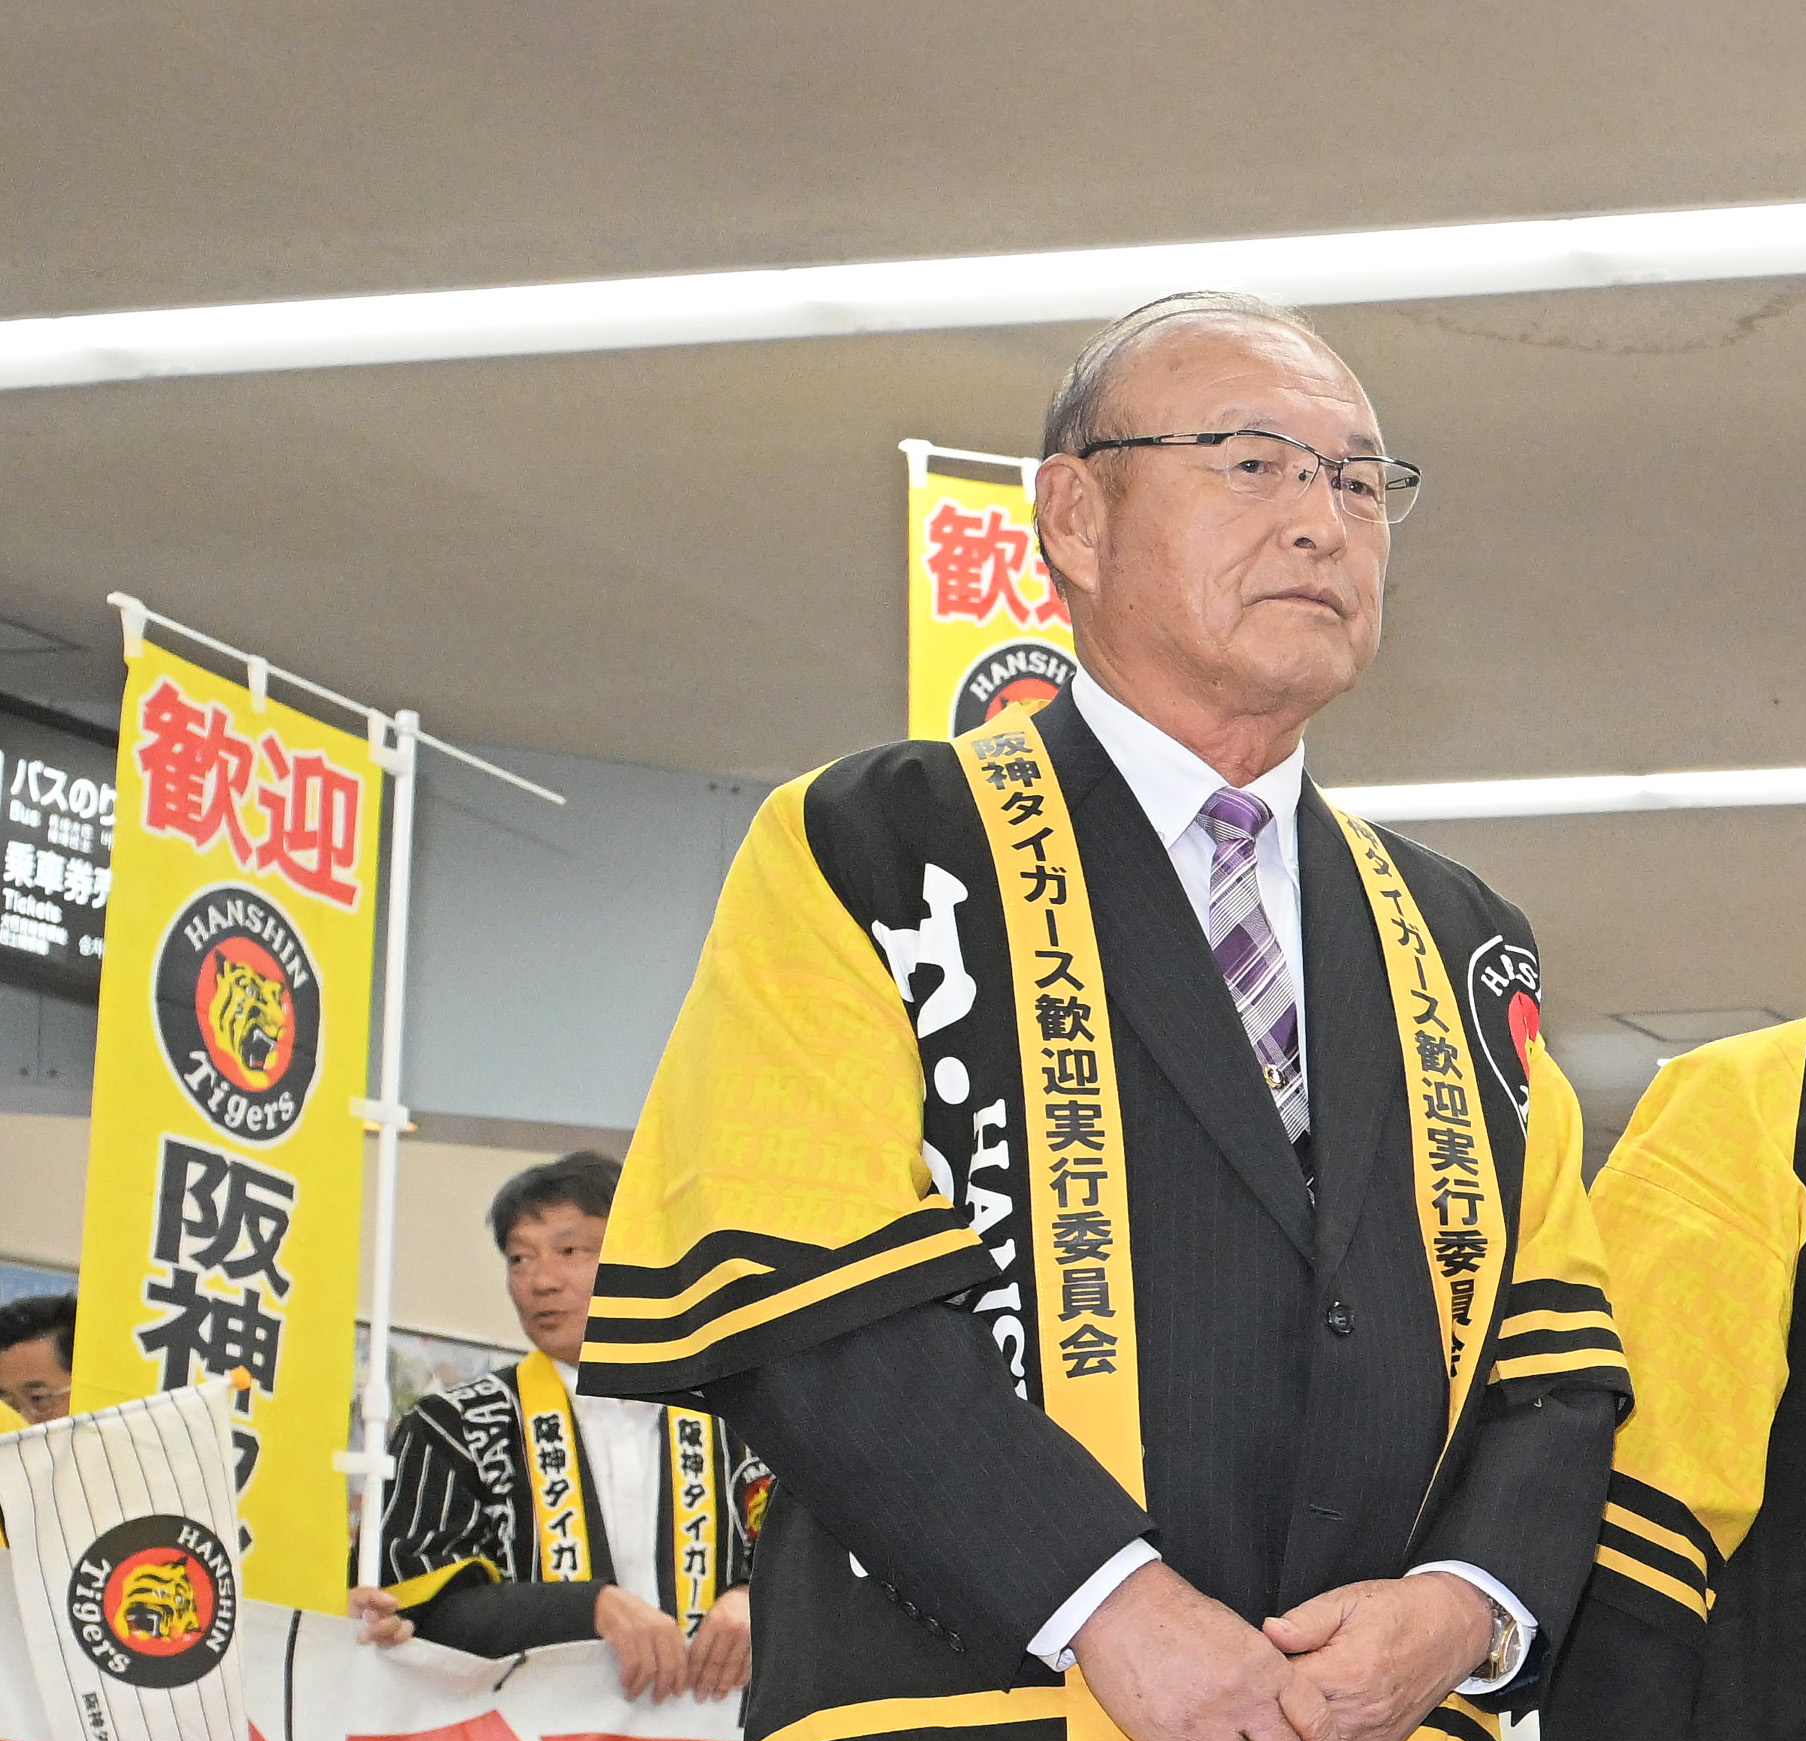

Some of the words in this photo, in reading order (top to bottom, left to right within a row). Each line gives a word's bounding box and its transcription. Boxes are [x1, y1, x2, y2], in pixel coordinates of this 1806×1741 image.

[139, 682, 359, 905] 歓迎
[184, 901, 308, 988] HANSHIN
[184, 1050, 295, 1132] Tigers
[971, 729, 1120, 1379] 阪神タイガース歓迎実行委員会
[1338, 810, 1488, 1378] 神タイガース歓迎実行委員会
[532, 1413, 578, 1581] 阪神タイガ
[72, 1558, 131, 1675] Tigers
[177, 1524, 234, 1653] HANSHIN
